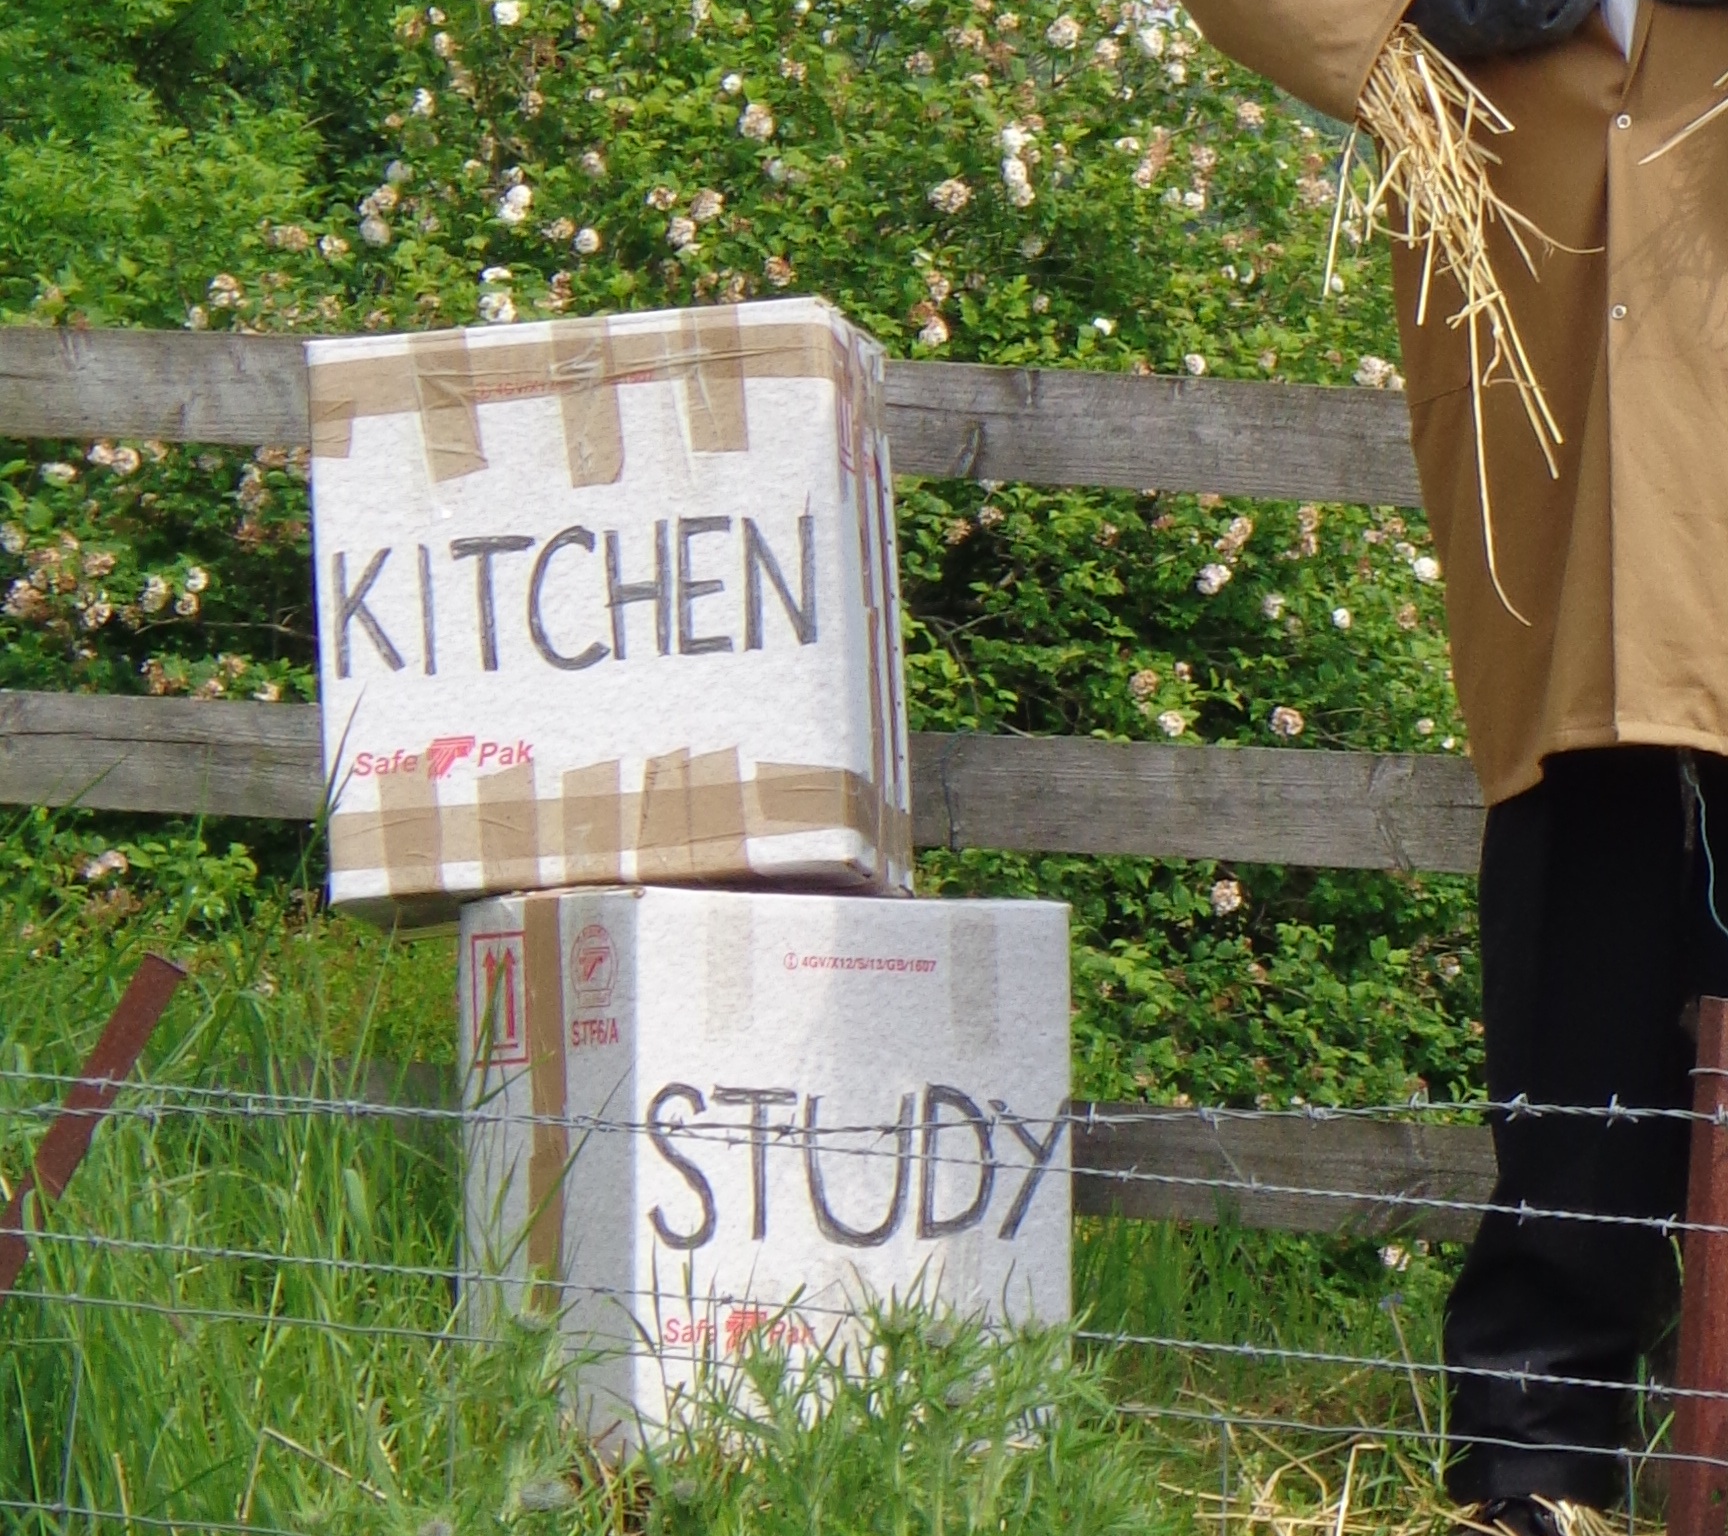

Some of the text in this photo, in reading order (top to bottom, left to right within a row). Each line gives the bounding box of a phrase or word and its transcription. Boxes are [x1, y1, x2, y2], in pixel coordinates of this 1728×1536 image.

[332, 514, 818, 679] KITCHEN
[354, 740, 535, 776] Safe Pak
[646, 1081, 1071, 1250] STUDY
